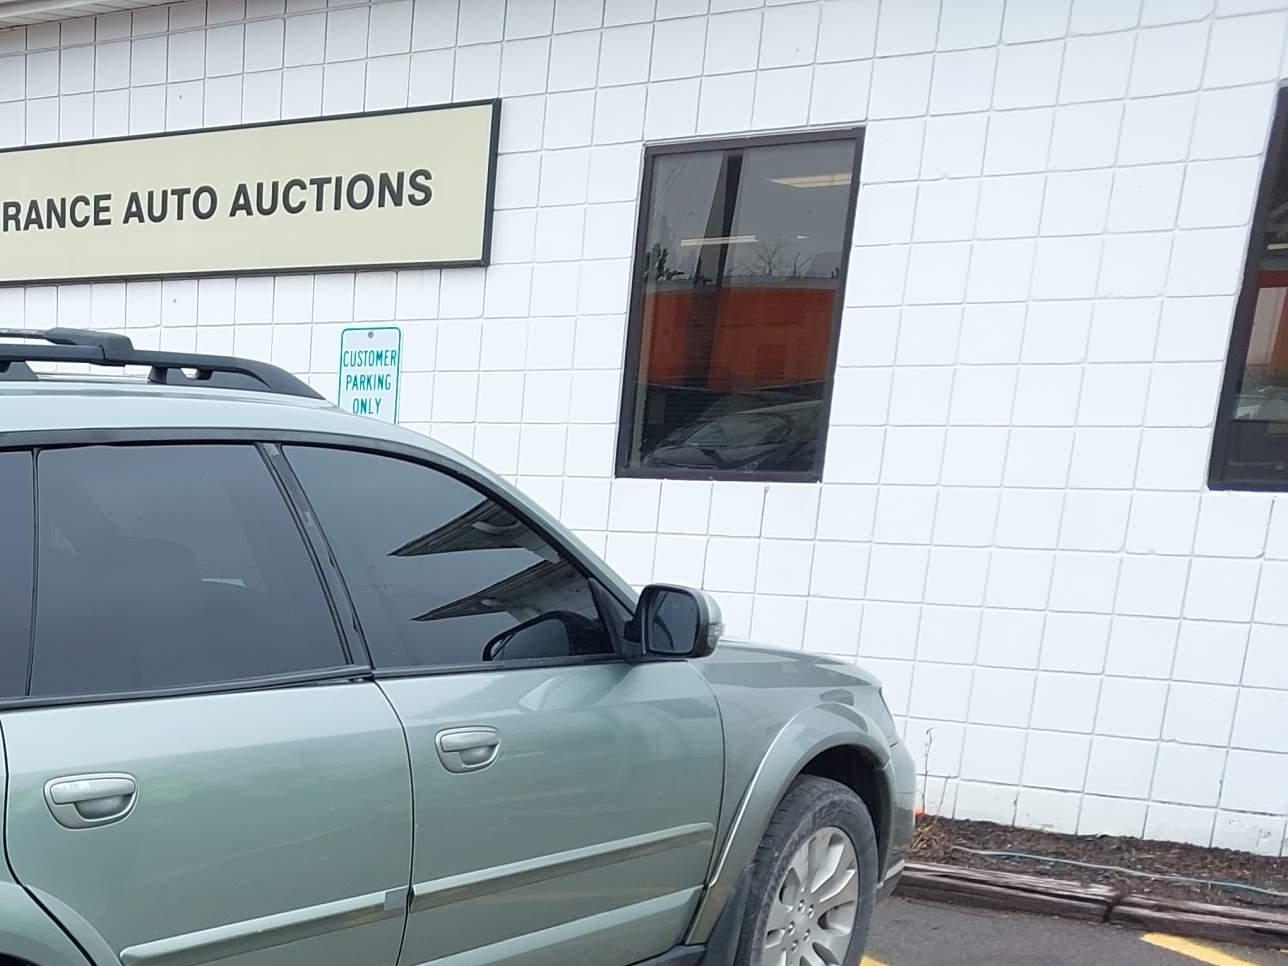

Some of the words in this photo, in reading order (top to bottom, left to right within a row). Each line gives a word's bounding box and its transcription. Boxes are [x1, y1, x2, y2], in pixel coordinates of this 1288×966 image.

[122, 185, 217, 224] AUTO
[229, 168, 433, 218] AUCTIONS
[343, 350, 397, 367] CUSTOMER
[345, 374, 391, 391] PARKING
[352, 398, 382, 414] ONLY
